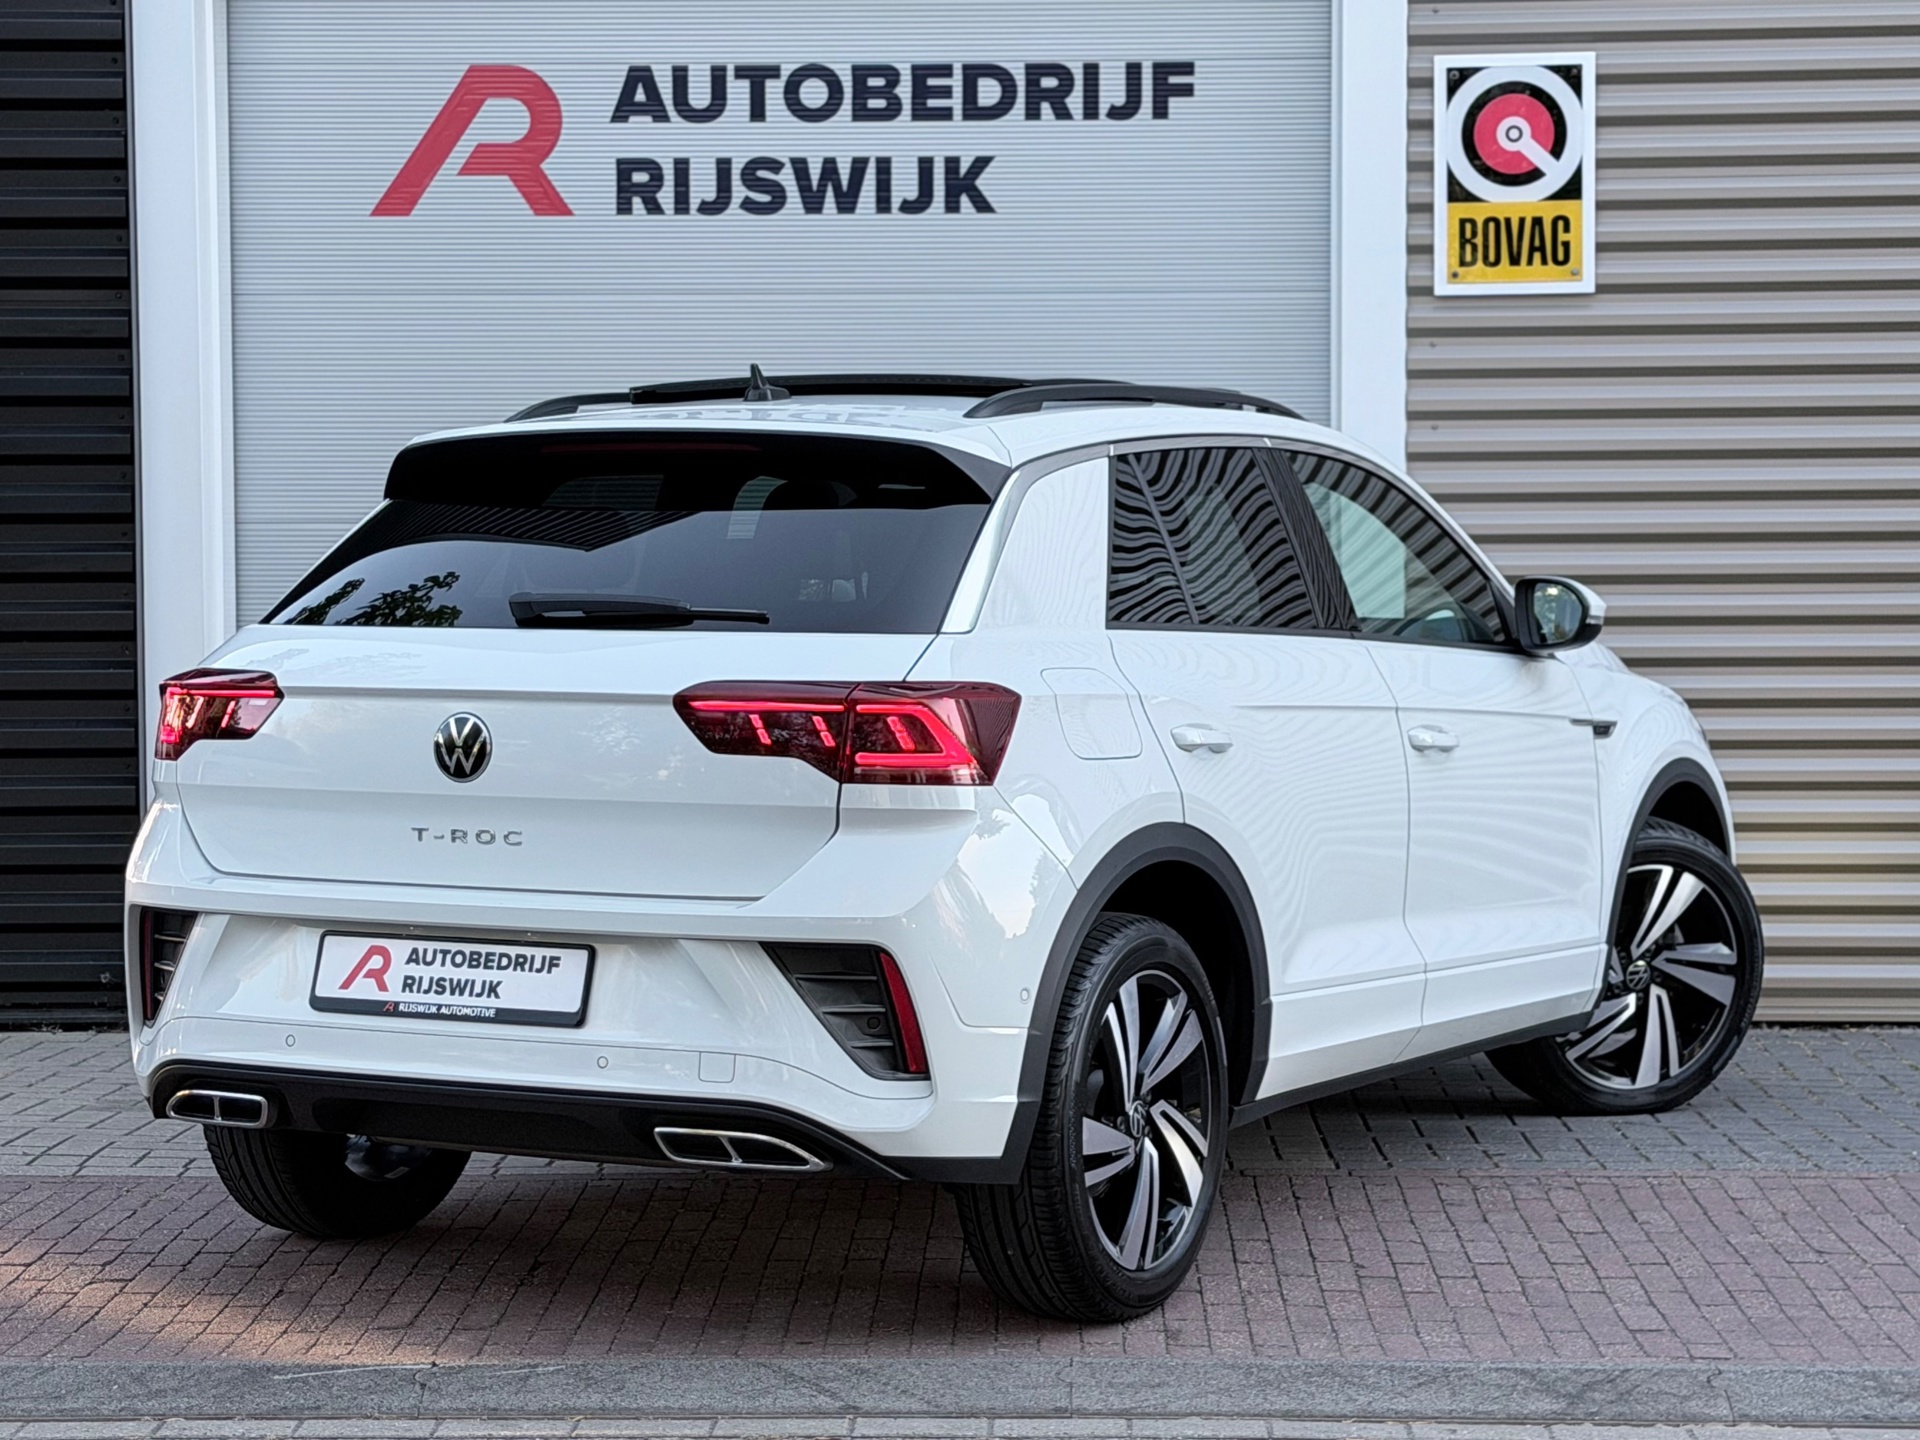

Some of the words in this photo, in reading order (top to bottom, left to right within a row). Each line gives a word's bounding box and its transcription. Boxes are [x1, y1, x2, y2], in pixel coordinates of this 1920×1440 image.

[609, 61, 1195, 123] AUTOBEDRIJF
[615, 156, 997, 216] RIJSWIJK
[1458, 215, 1572, 268] BOVAG
[411, 827, 523, 846] T-ROC
[404, 947, 562, 975] AUTOBEDRIJF
[401, 975, 503, 999] RIJSWIJK
[398, 1003, 438, 1014] RIJSWIJK
[439, 1005, 496, 1018] AUTOMOTIVE
